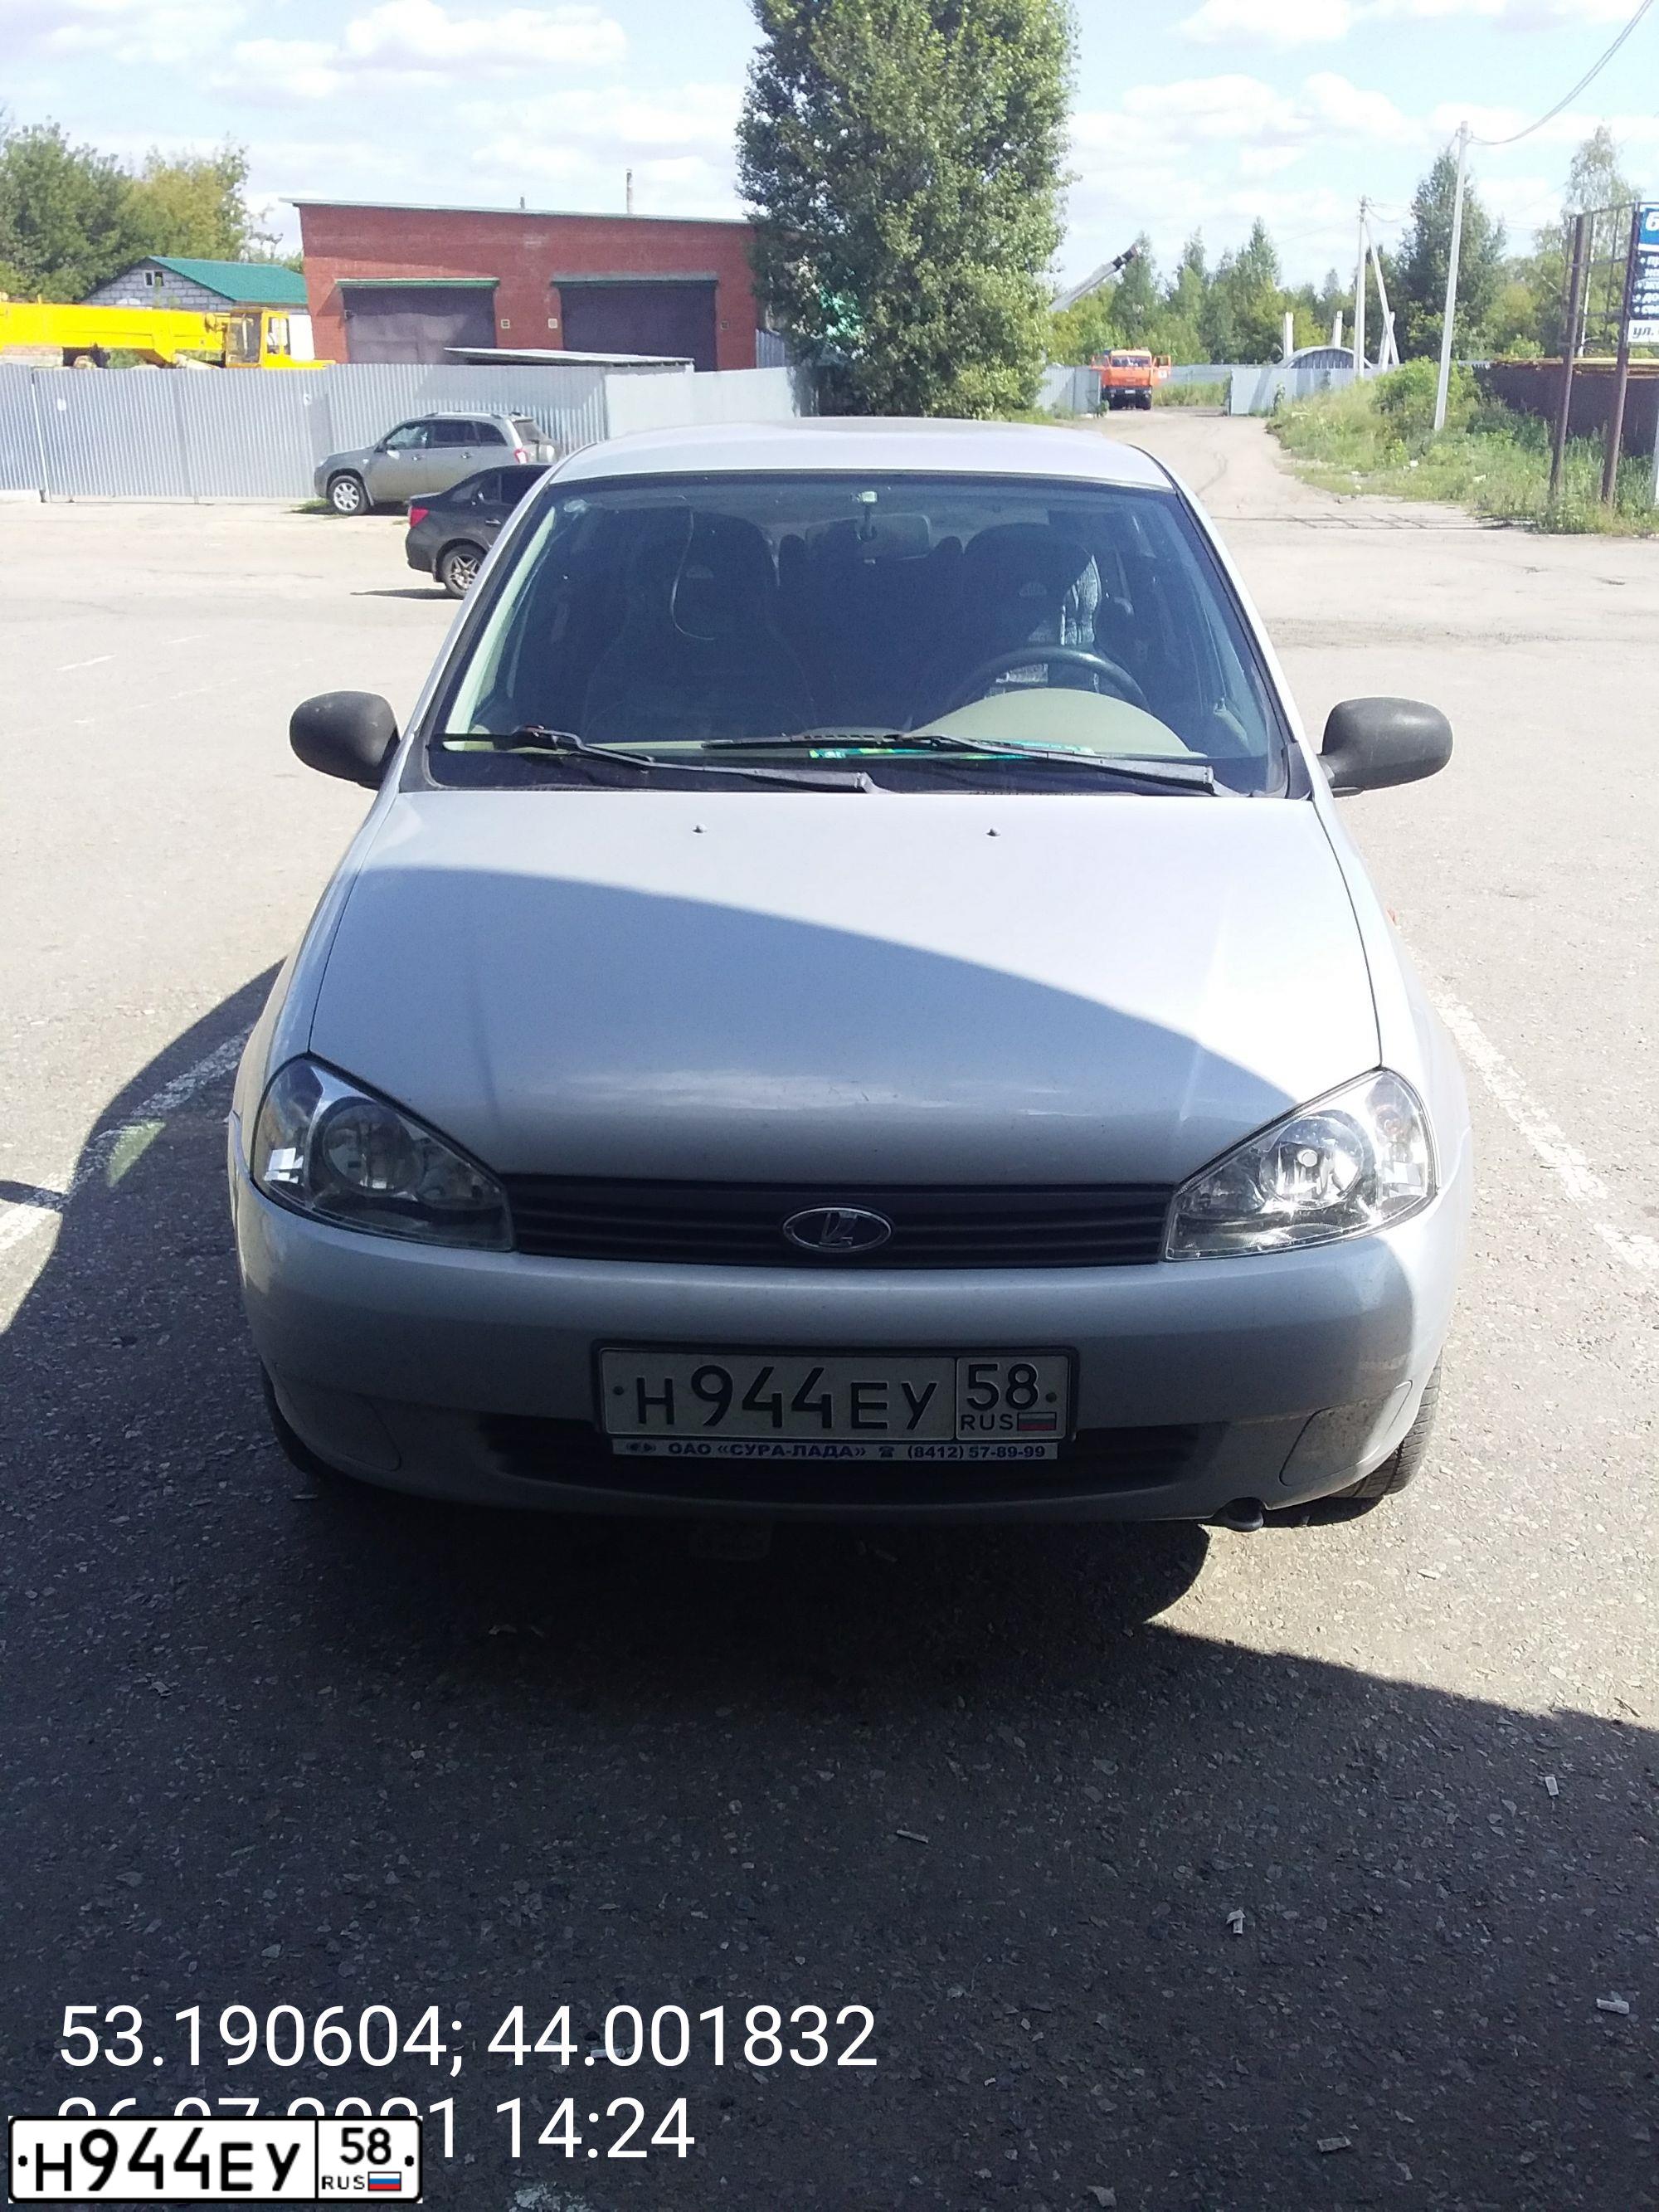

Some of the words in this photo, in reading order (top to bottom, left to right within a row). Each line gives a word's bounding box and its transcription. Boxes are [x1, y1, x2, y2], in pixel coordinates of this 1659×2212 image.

[635, 1365, 937, 1430] Н944ЕУ
[966, 1363, 1039, 1412] 58
[960, 1413, 1014, 1431] RUS
[668, 1443, 713, 1456] ОАО
[718, 1443, 867, 1458] «СУРА-ЛАДА»
[907, 1445, 965, 1459] (8412)
[968, 1445, 1046, 1458] 57-89-99
